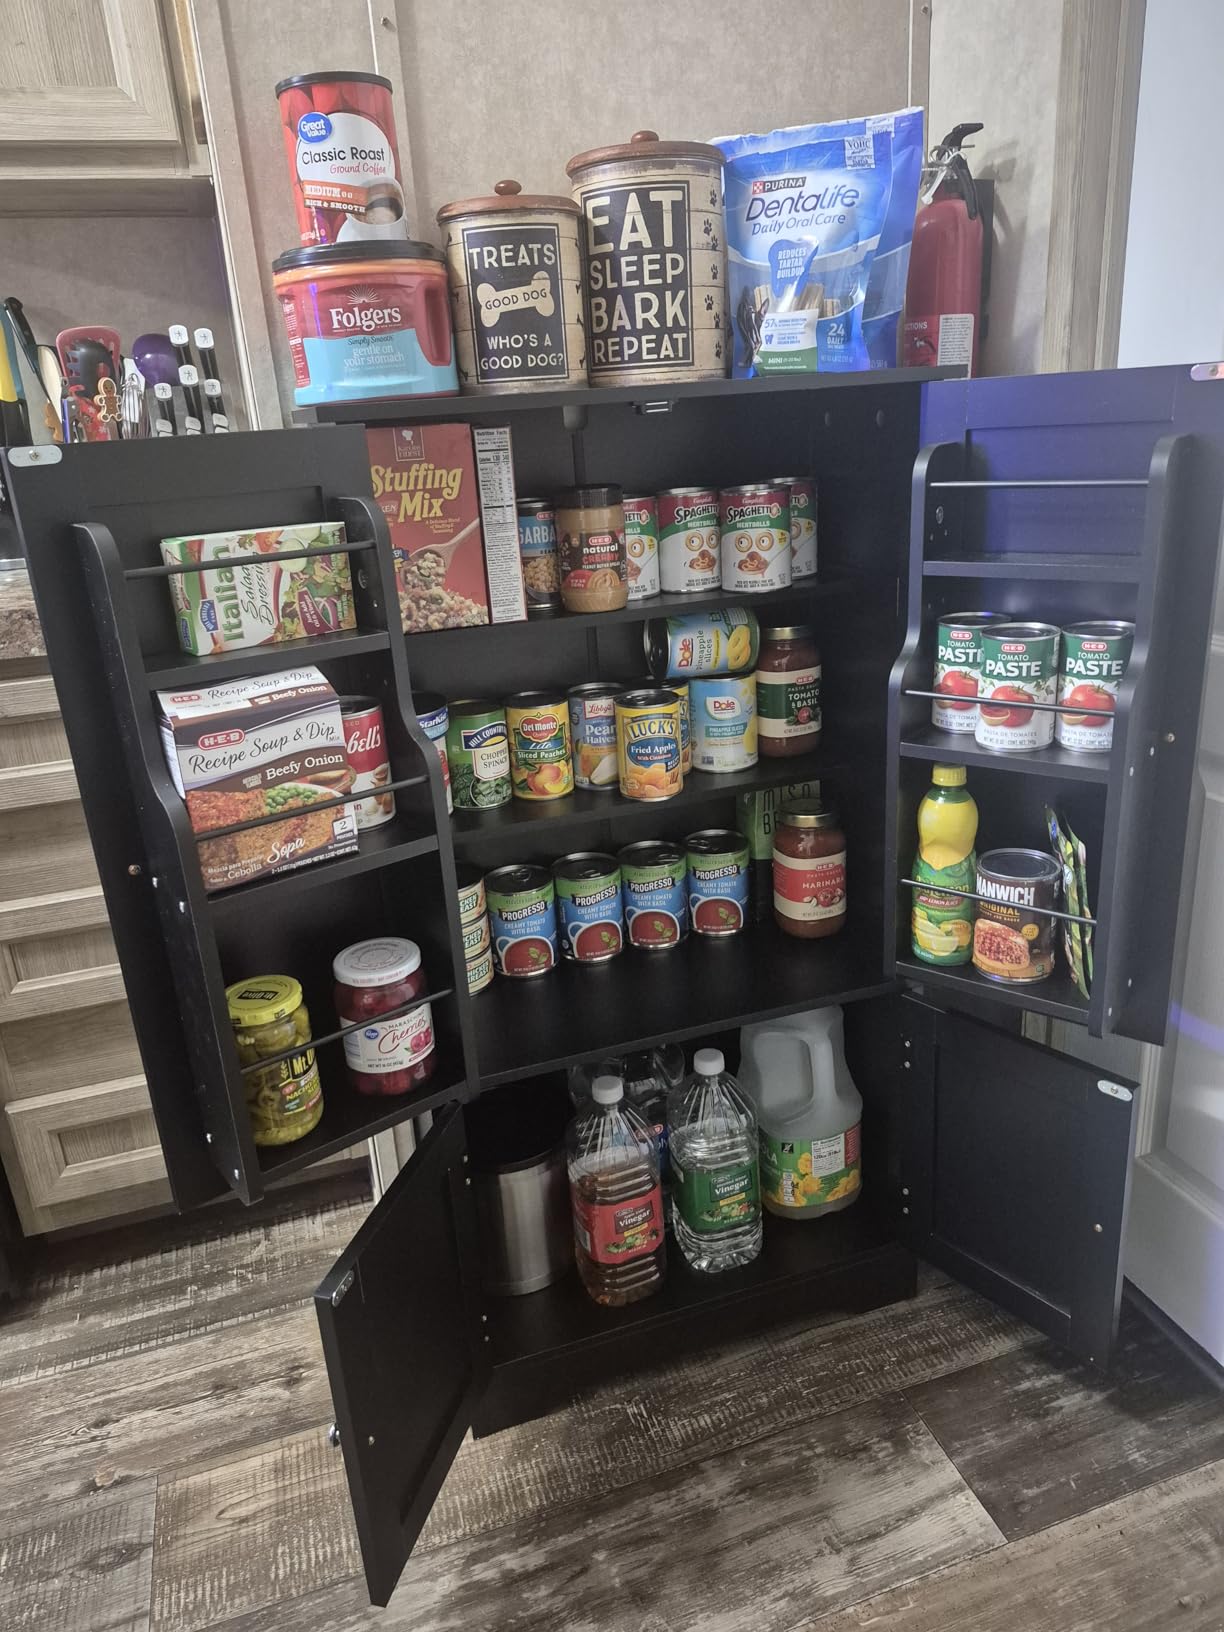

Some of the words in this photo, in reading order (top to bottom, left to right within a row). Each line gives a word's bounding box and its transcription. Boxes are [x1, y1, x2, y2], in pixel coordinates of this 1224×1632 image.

[301, 119, 326, 132] Great
[307, 129, 326, 137] Value
[302, 148, 346, 165] Classic
[350, 147, 385, 161] Roast
[329, 162, 360, 174] Ground
[362, 162, 386, 176] Coffee
[304, 184, 341, 197] MEDIUM
[764, 178, 804, 192] PURINA
[330, 202, 366, 213] SMOOTH
[585, 189, 684, 255] EAT
[751, 219, 784, 236] Daily
[785, 213, 814, 229] Oral
[815, 212, 847, 226] Care
[469, 243, 556, 270] TREATS
[777, 247, 807, 260] REDUCES
[779, 258, 803, 269] TARTAR
[590, 253, 685, 290] SLEEP
[776, 268, 805, 280] BUILDUP
[484, 293, 521, 311] GOOD
[522, 287, 547, 303] DOG
[591, 289, 688, 334] BARK
[329, 307, 402, 332] Folgers
[828, 323, 845, 336] 24
[347, 337, 371, 346] Simply
[370, 335, 394, 343] Smooth
[486, 333, 538, 350] WHO'S
[542, 332, 552, 347] A
[593, 333, 688, 362] REPEAT
[826, 336, 844, 345] DAILY
[352, 345, 381, 358] gentle
[383, 344, 394, 353] on
[343, 357, 365, 368] your
[366, 353, 405, 364] stomach
[480, 356, 522, 370] GOOD
[526, 352, 564, 367] DOG?
[768, 356, 783, 364] MINI
[371, 463, 464, 500] Stuffing
[397, 491, 445, 523] Mix
[674, 504, 718, 525] SPAGHETTI
[687, 519, 717, 528] MEATBALLS
[736, 520, 771, 528] MEATBALLS
[518, 525, 556, 545] GARBA
[582, 543, 619, 554] natural
[582, 553, 620, 564] CREAMY
[212, 545, 245, 642] Italian
[705, 639, 713, 663] slices
[947, 640, 976, 648] TOMATO
[678, 638, 691, 668] Dole
[997, 653, 1030, 661] TOMATO
[1077, 651, 1111, 660] TOMATO
[985, 659, 1042, 677] PASTE
[1065, 657, 1124, 676] PASTE
[207, 684, 250, 700] Recipe
[252, 679, 281, 691] Soup
[290, 671, 313, 684] Dip
[272, 690, 297, 701] Beefy
[298, 684, 328, 694] Onion
[787, 689, 820, 700] TOMATO
[713, 700, 736, 709] Dole
[796, 698, 818, 708] BASIL
[522, 723, 534, 732] Del
[534, 721, 557, 731] Monte
[629, 720, 675, 739] LUCK'S
[709, 725, 731, 733] PINEAPPLE
[346, 724, 381, 754] bell's
[469, 734, 483, 748] HILL
[1078, 730, 1086, 738] DE
[188, 749, 247, 775] Recipe
[249, 735, 290, 758] Soup
[293, 727, 304, 742] &
[306, 721, 336, 741] Dip
[529, 742, 552, 750] Lite
[630, 745, 652, 754] Fried
[653, 742, 677, 755] Apples
[480, 748, 508, 761] CHOPPE
[517, 751, 538, 759] Sliced
[540, 749, 566, 758] Peaches
[265, 761, 302, 780] Beefy
[304, 753, 345, 769] Onion
[339, 820, 348, 831] 2
[267, 837, 306, 863] Sopa
[207, 863, 228, 874] Mezcla
[228, 861, 242, 870] para
[227, 862, 263, 880] Cebolla
[695, 865, 738, 880] PROGRESSO
[630, 877, 673, 893] PROGRESSO
[575, 885, 616, 906] PROGRESSO
[502, 901, 546, 921] PROGRESSO
[577, 906, 599, 915] CREAMY
[600, 902, 616, 911] TOMATO
[527, 917, 546, 926] TOMATO
[584, 912, 599, 920] WITH
[511, 927, 526, 935] WITH
[388, 1009, 425, 1029] MARASCHINO
[378, 1016, 426, 1054] Cherries
[714, 1178, 749, 1195] Vinegar
[619, 1208, 651, 1227] Vinegar
